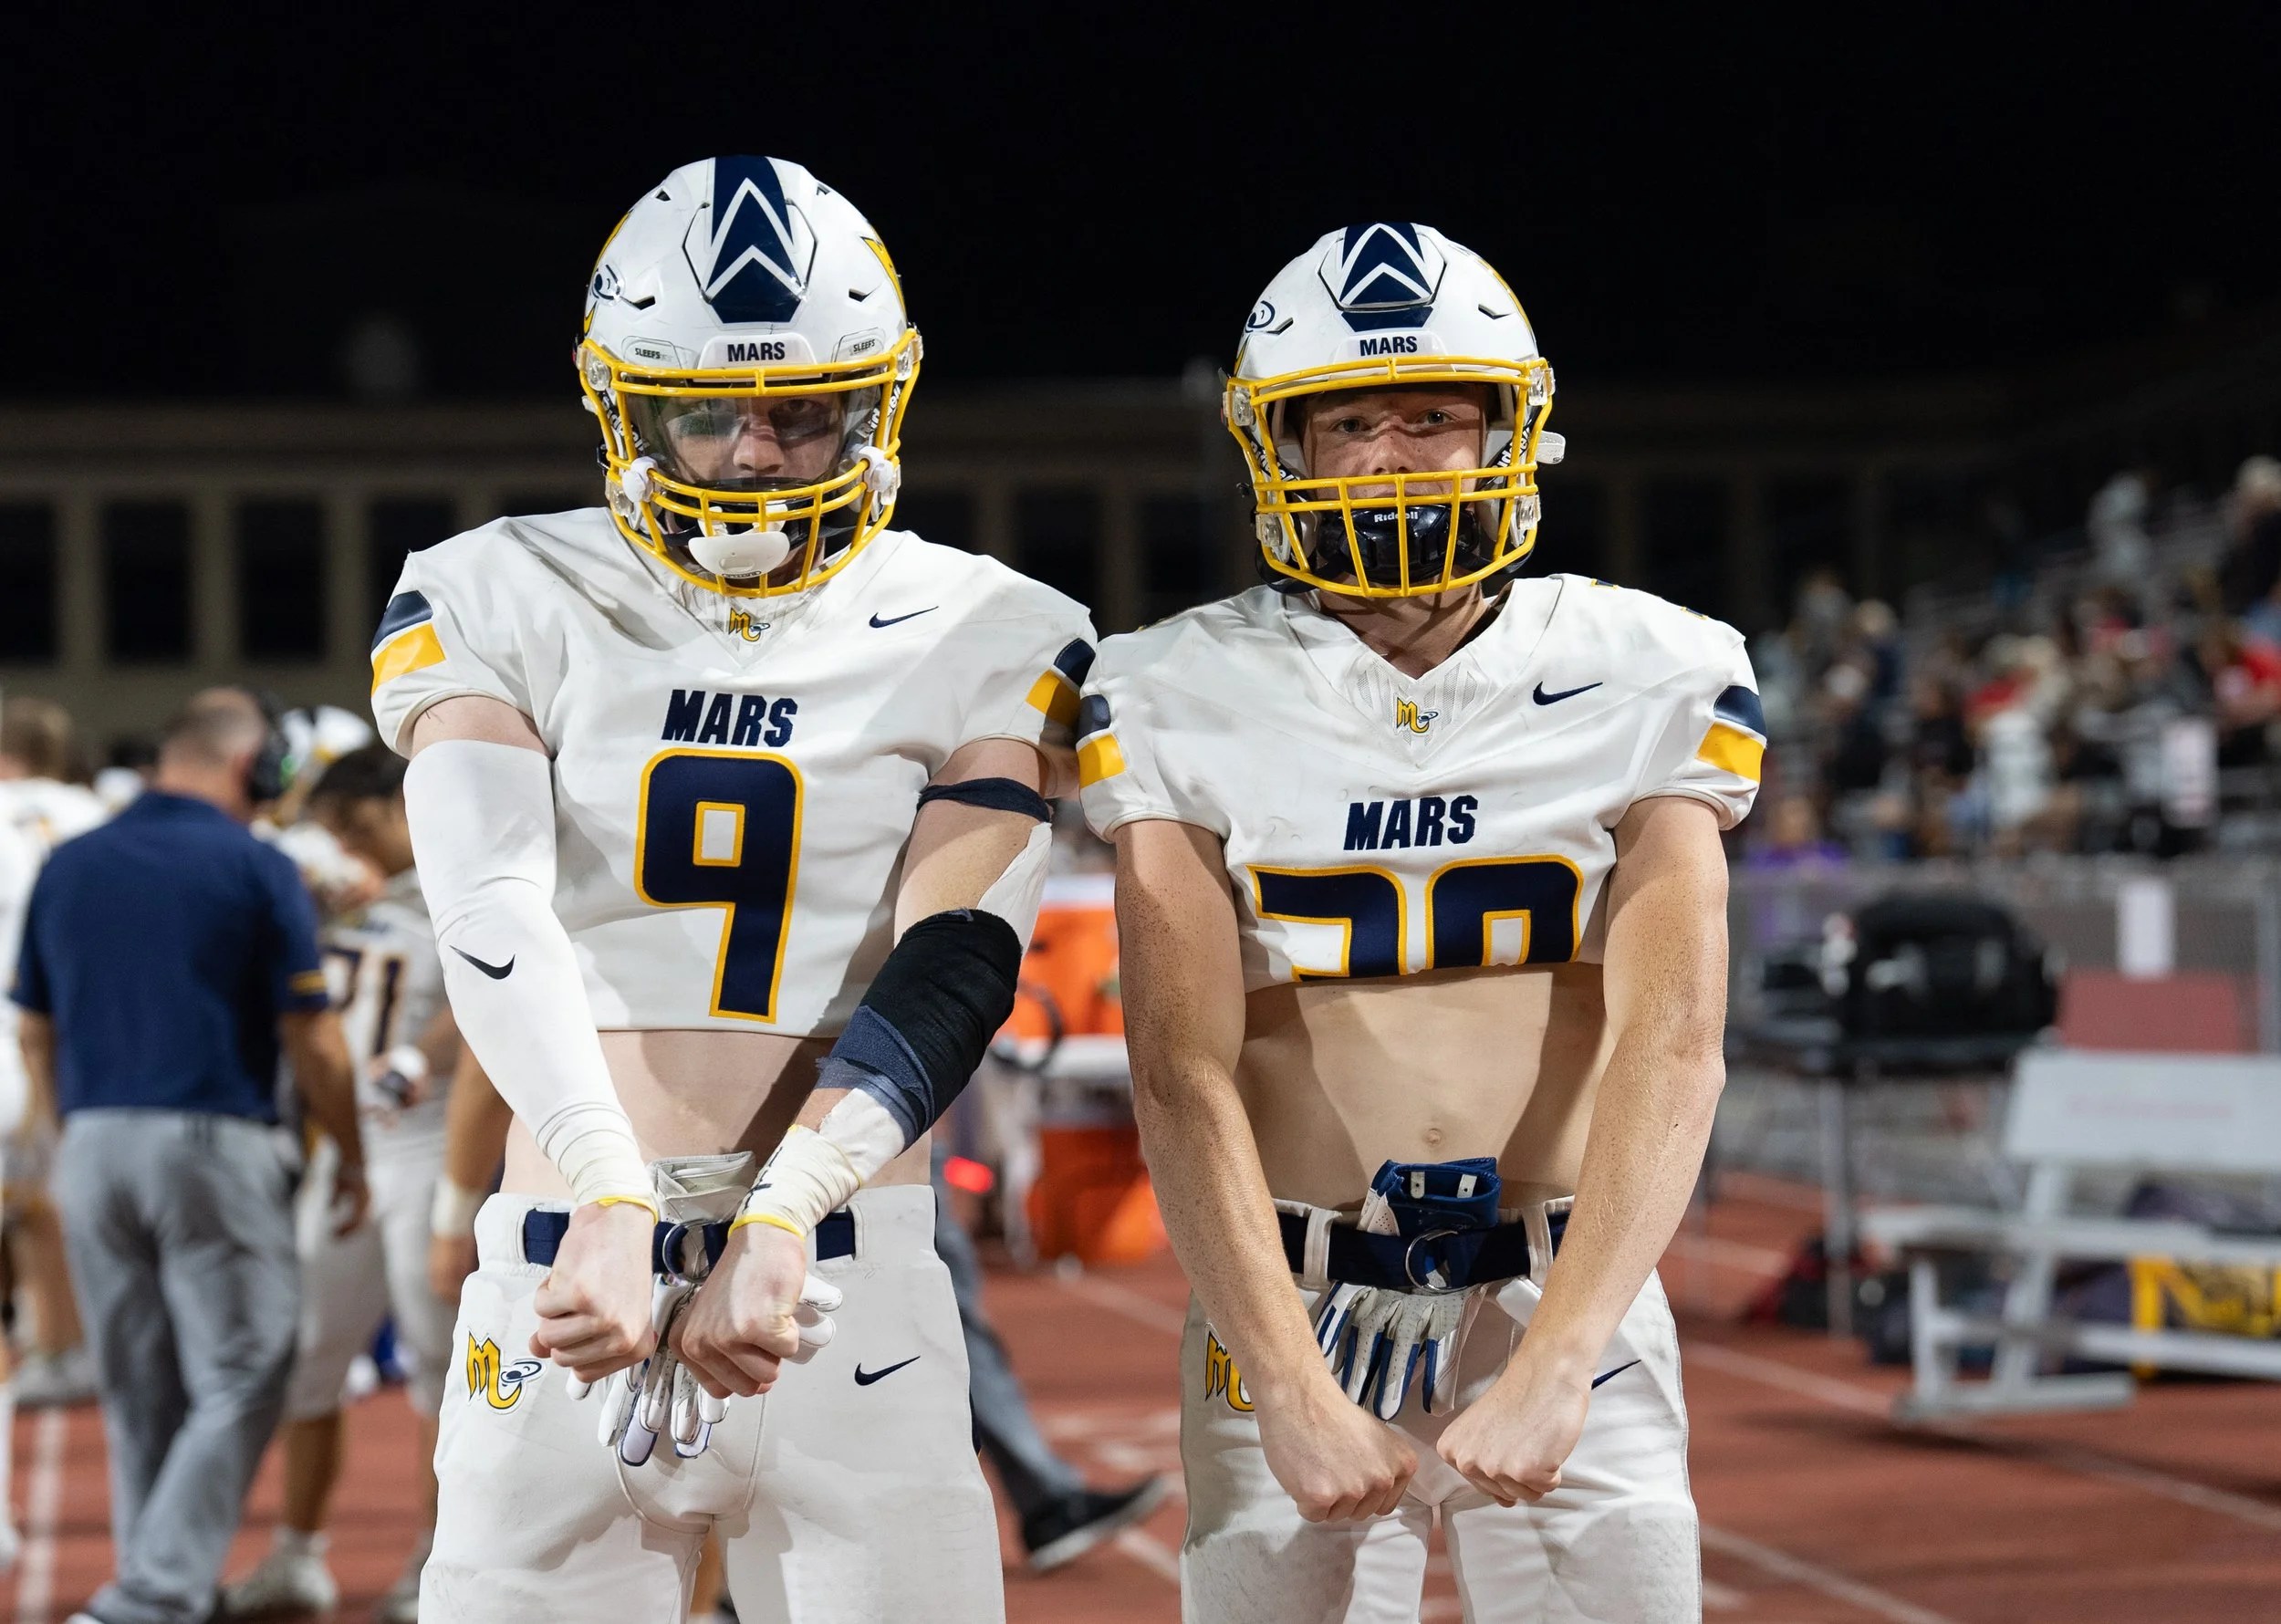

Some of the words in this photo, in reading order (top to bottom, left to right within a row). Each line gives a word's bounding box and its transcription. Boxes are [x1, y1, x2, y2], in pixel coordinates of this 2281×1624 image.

[727, 341, 786, 362] MARS
[1359, 335, 1419, 357] MARS
[661, 689, 798, 748] MARS
[1343, 795, 1478, 851] MARS
[634, 747, 806, 1025] 9
